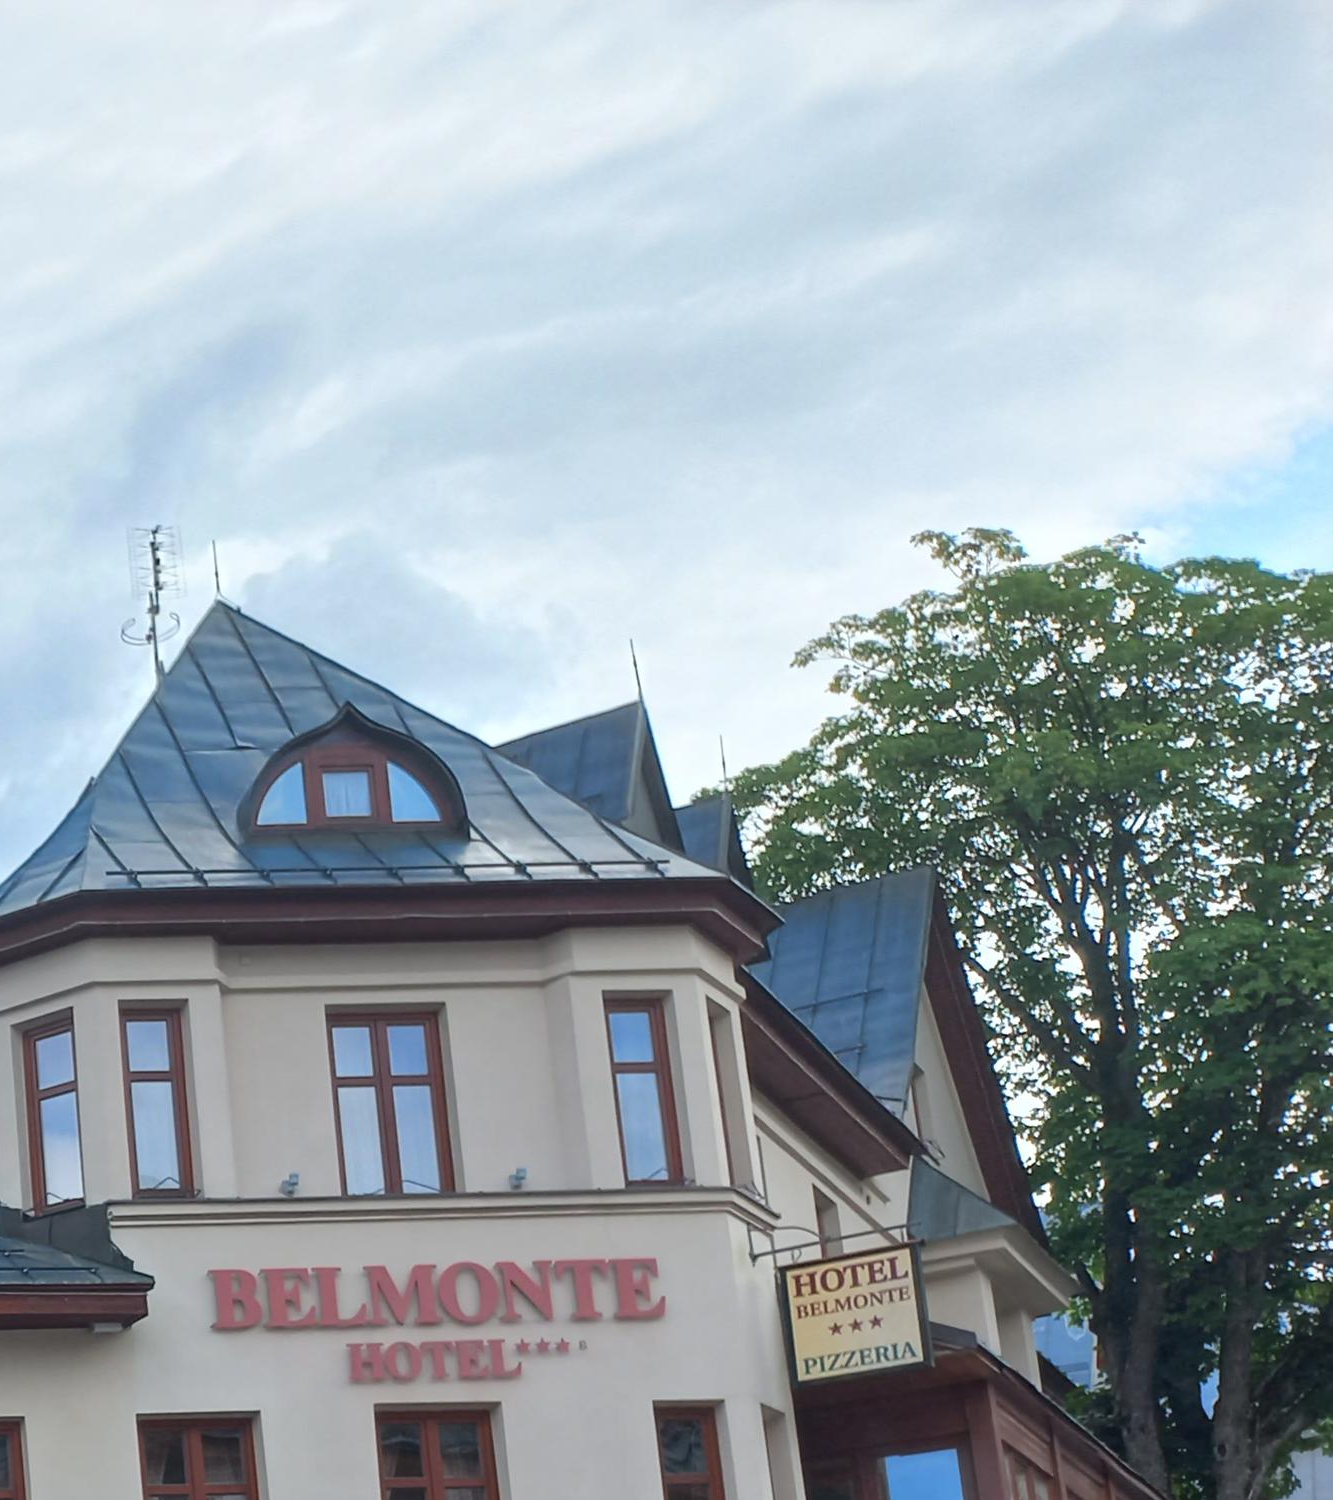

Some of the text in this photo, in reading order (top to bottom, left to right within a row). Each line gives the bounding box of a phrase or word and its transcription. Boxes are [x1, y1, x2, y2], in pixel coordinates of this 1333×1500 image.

[207, 1257, 667, 1332] BELMONTE
[791, 1256, 909, 1298] HOTEL
[796, 1286, 911, 1319] BELMONTE
[346, 1338, 523, 1383] HOTEL
[803, 1341, 918, 1375] PIZZERIA
